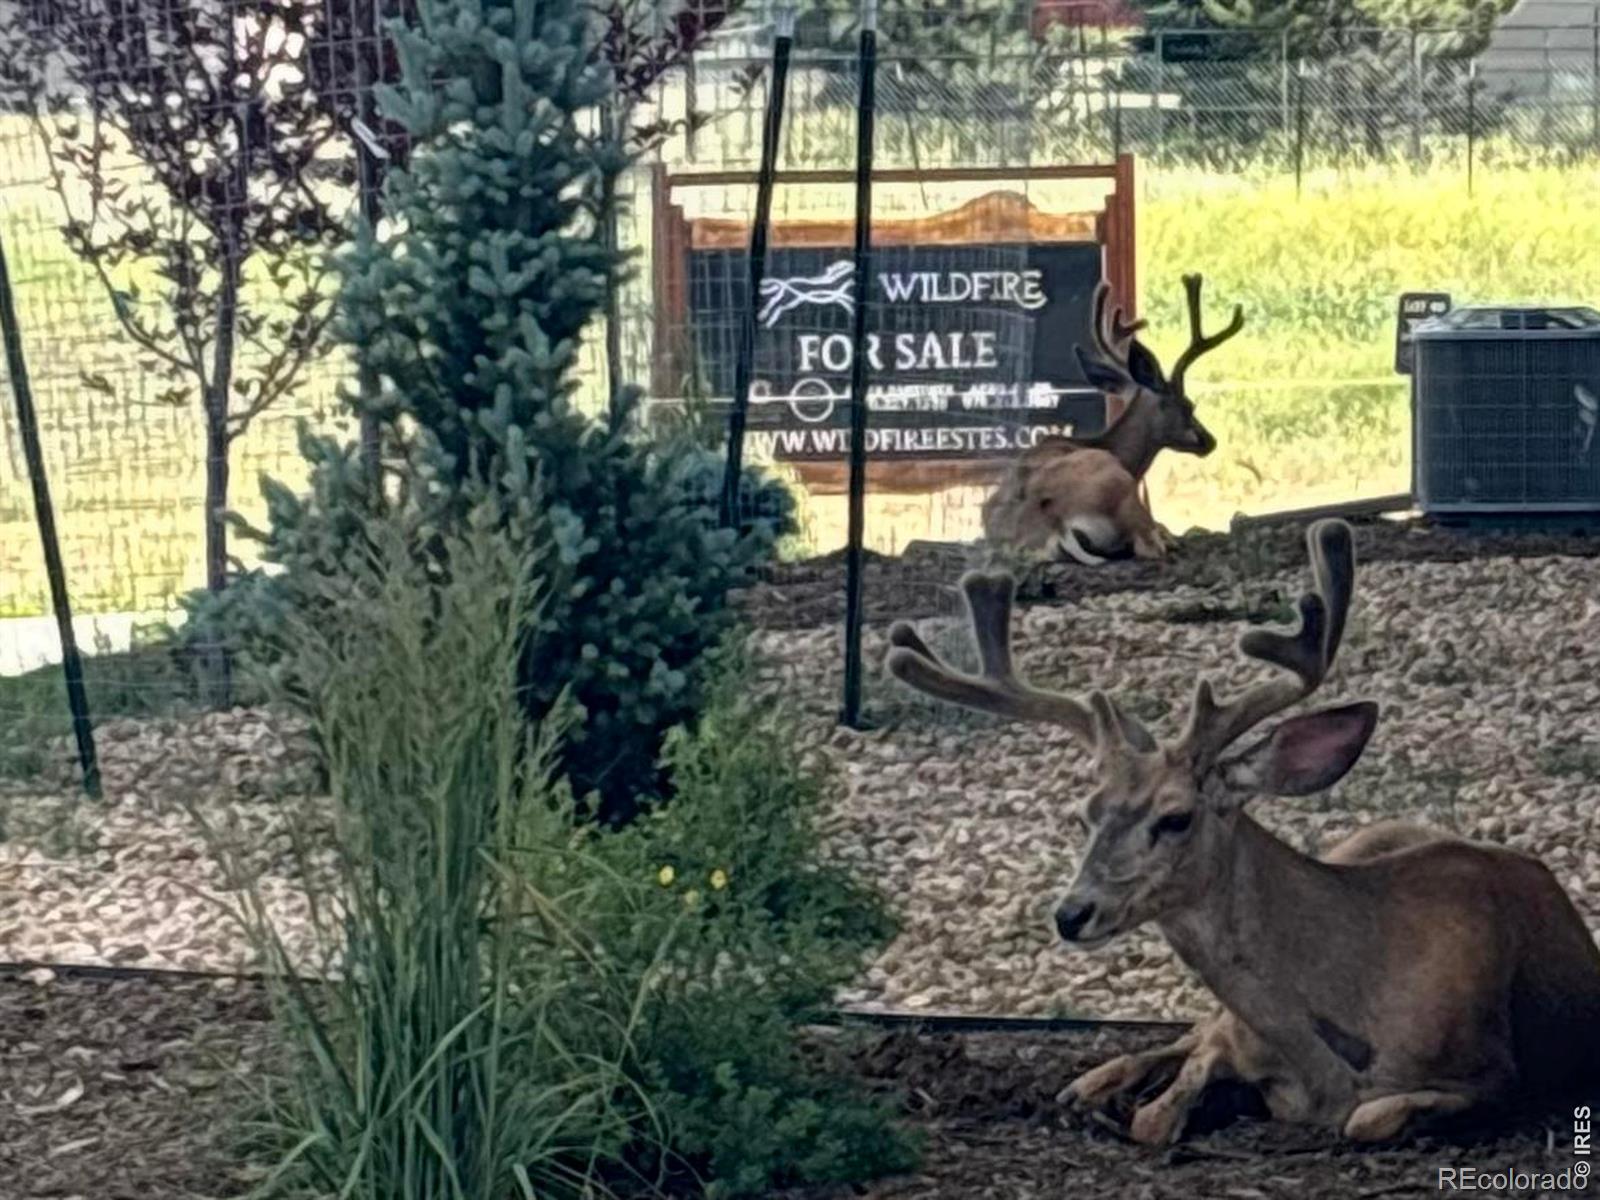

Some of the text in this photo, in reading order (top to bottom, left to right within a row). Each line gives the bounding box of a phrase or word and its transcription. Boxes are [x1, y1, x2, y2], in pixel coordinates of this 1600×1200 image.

[877, 270, 1047, 309] WILDFIRE
[798, 330, 997, 371] FOR SALE
